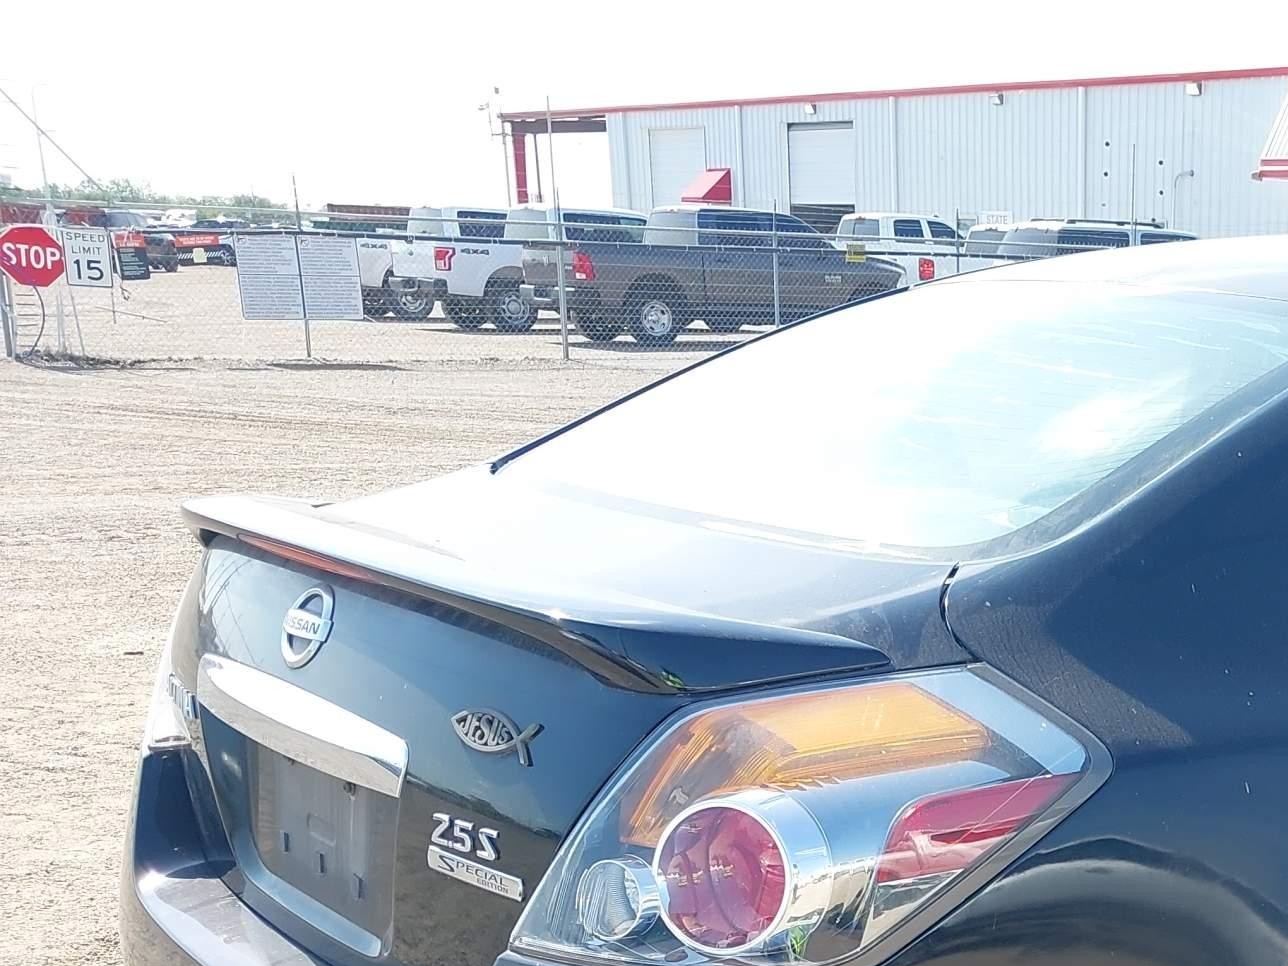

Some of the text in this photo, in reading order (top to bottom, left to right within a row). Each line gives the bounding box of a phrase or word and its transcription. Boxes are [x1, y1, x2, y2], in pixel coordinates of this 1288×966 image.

[986, 215, 1008, 225] STATE
[65, 231, 105, 242] SPEED
[2, 242, 61, 270] STOP
[71, 246, 102, 256] LIMIT
[73, 259, 104, 281] 15
[284, 614, 320, 635] SSAN
[460, 712, 513, 747] JESUS
[437, 854, 509, 888] SPECIAL
[476, 877, 509, 895] EDITION
